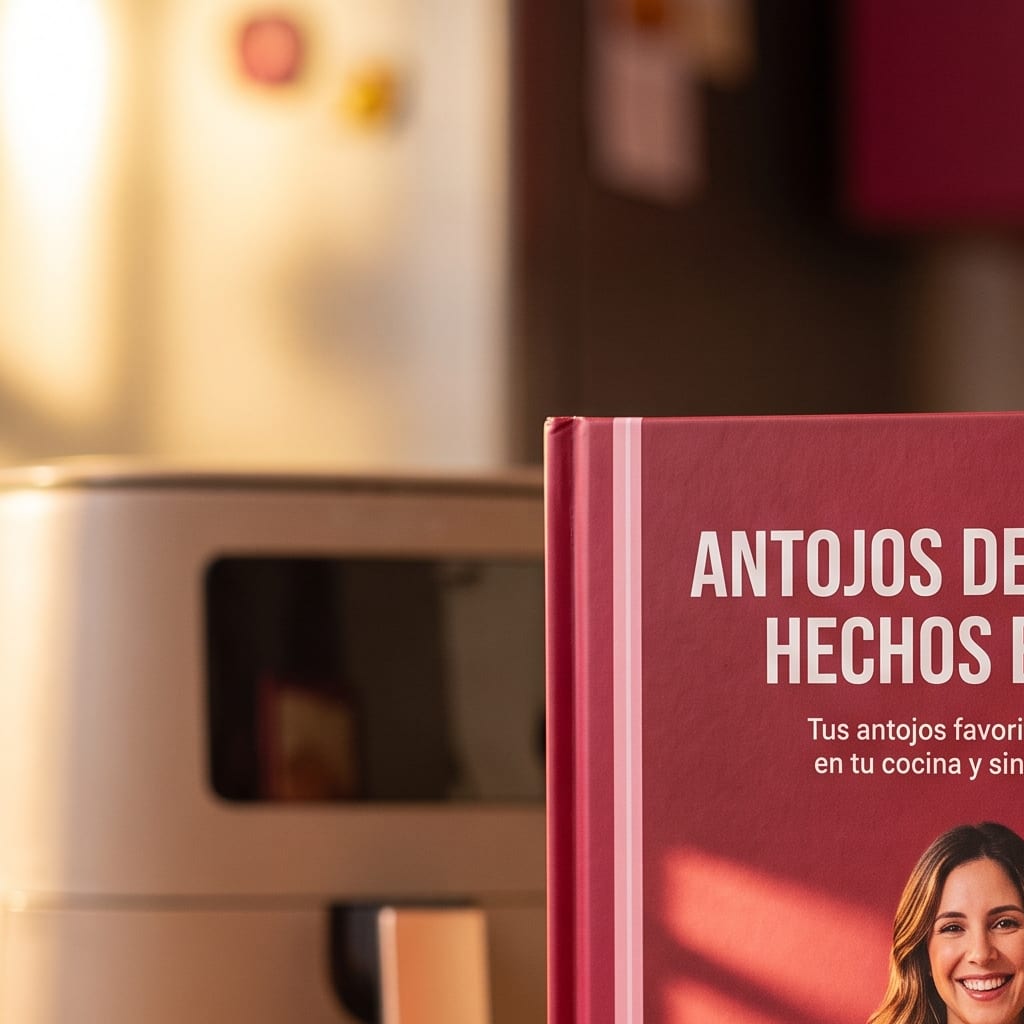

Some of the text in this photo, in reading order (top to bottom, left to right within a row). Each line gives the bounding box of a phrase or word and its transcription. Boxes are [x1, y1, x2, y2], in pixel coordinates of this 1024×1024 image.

[690, 528, 943, 598] ANTOJOS
[766, 616, 992, 685] HECHOS
[807, 717, 850, 741] Tus
[856, 717, 947, 747] antojos
[814, 756, 843, 774] en
[849, 753, 874, 774] tu
[881, 751, 962, 775] cocina
[968, 757, 983, 781] y
[989, 751, 1024, 775] sin
